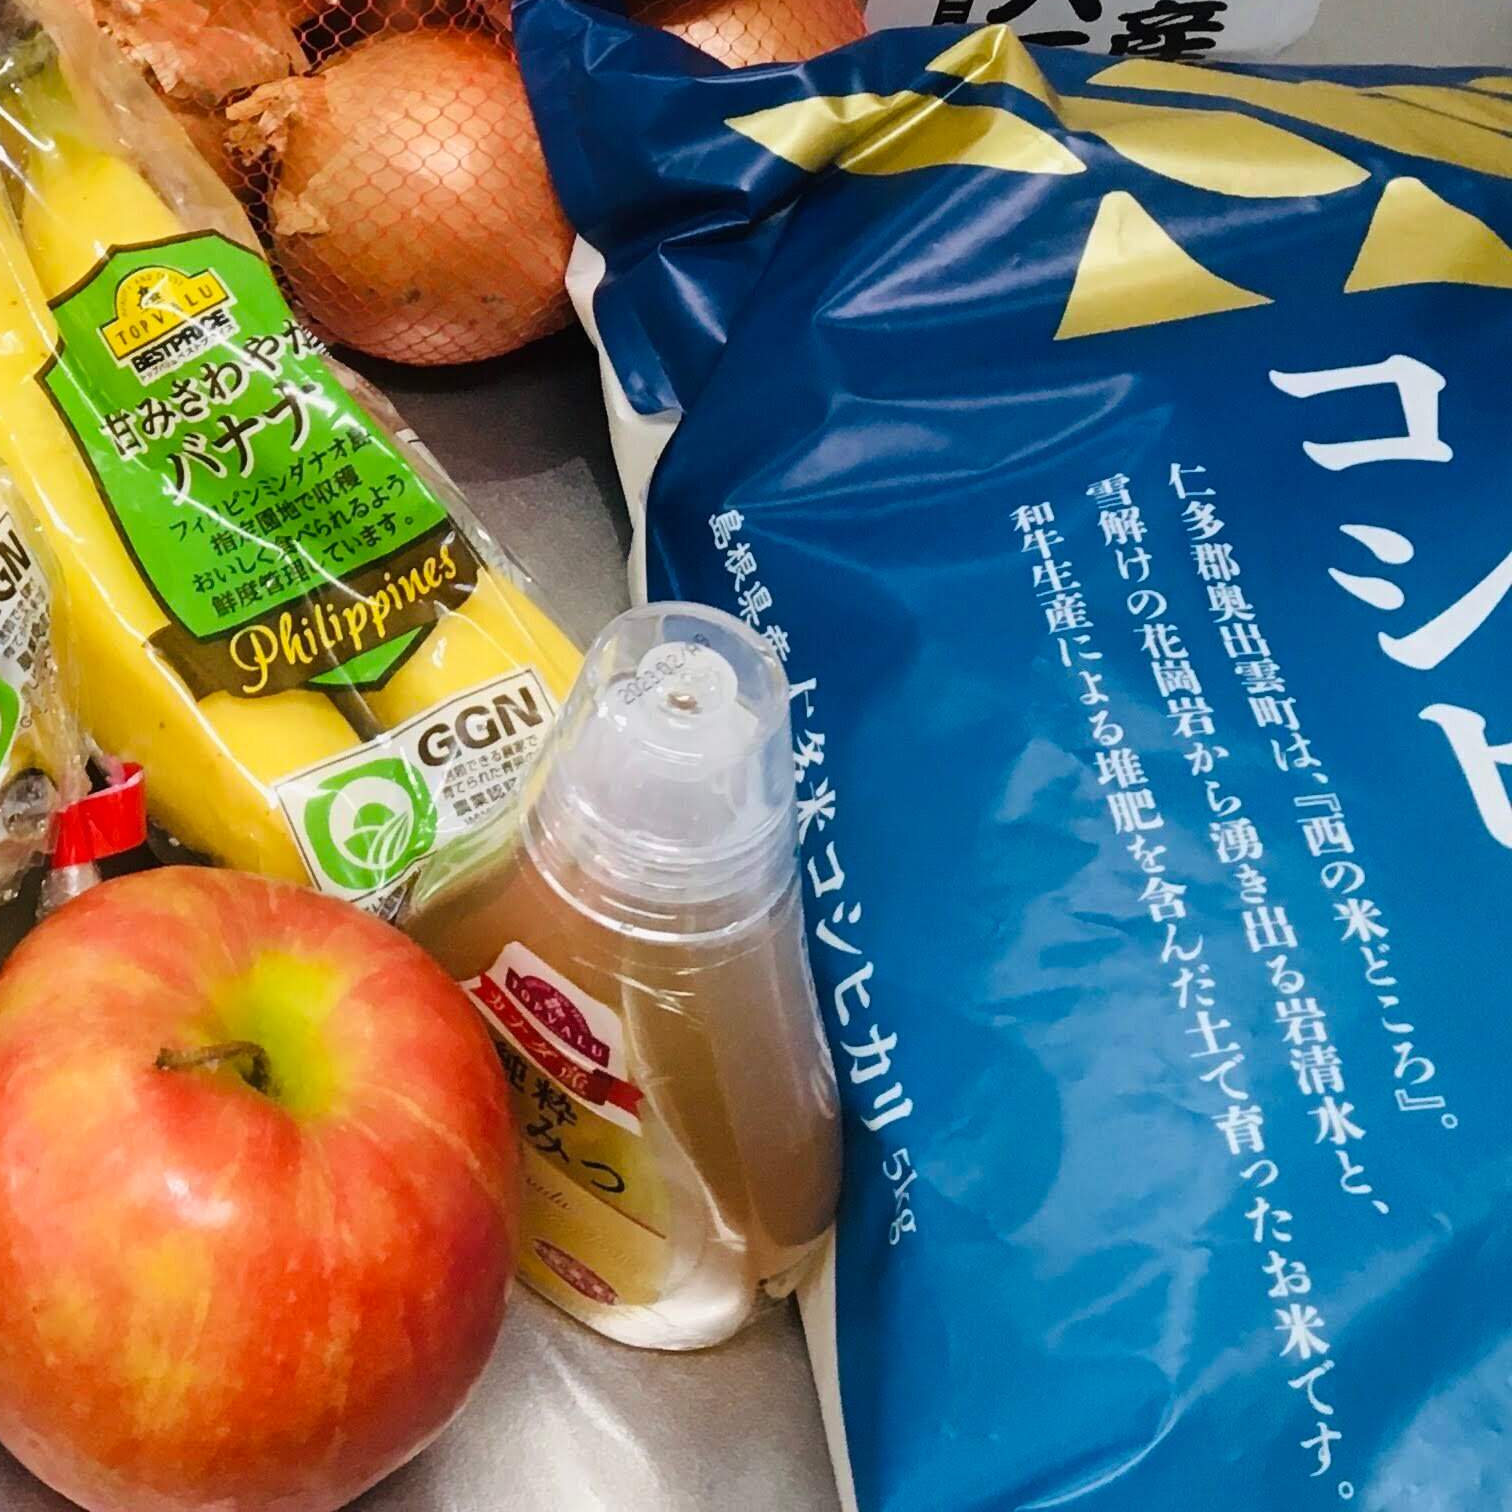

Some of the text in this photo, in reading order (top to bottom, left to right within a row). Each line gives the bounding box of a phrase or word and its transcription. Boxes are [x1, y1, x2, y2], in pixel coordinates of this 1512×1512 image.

[115, 284, 214, 346] TOPVLU
[166, 380, 326, 503] バナナ
[229, 544, 458, 695] Philippines
[418, 687, 544, 766] GGN
[511, 978, 604, 1059] TOPVALU
[883, 1148, 918, 1246] 5kg
